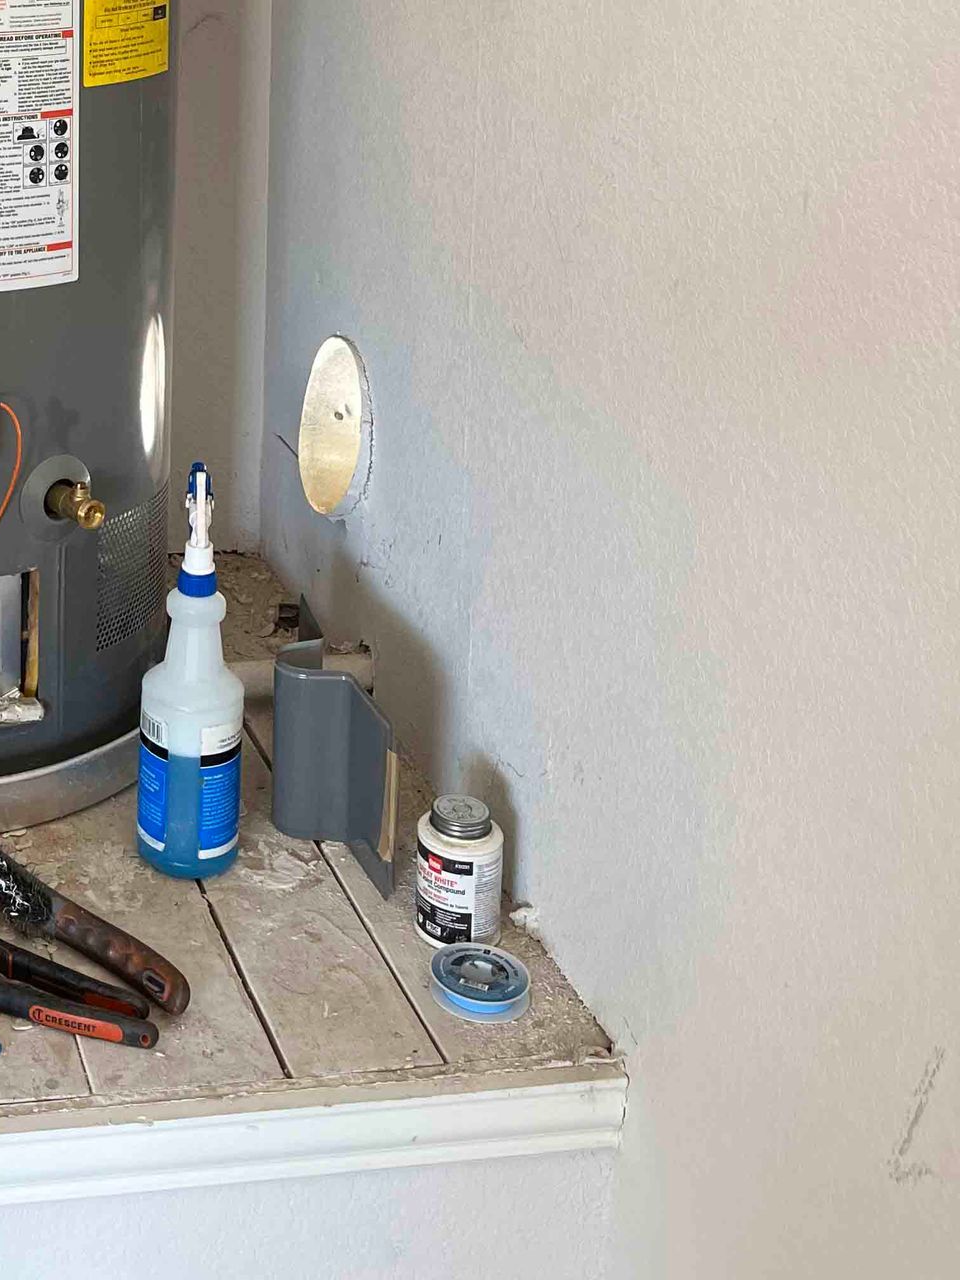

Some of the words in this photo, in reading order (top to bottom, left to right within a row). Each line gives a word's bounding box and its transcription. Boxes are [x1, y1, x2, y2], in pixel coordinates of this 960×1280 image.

[2, 114, 38, 122] INSTRUCTIONS
[23, 246, 46, 255] APPLIANCE
[434, 881, 466, 896] Compound
[45, 1013, 97, 1033] CRESCENT
